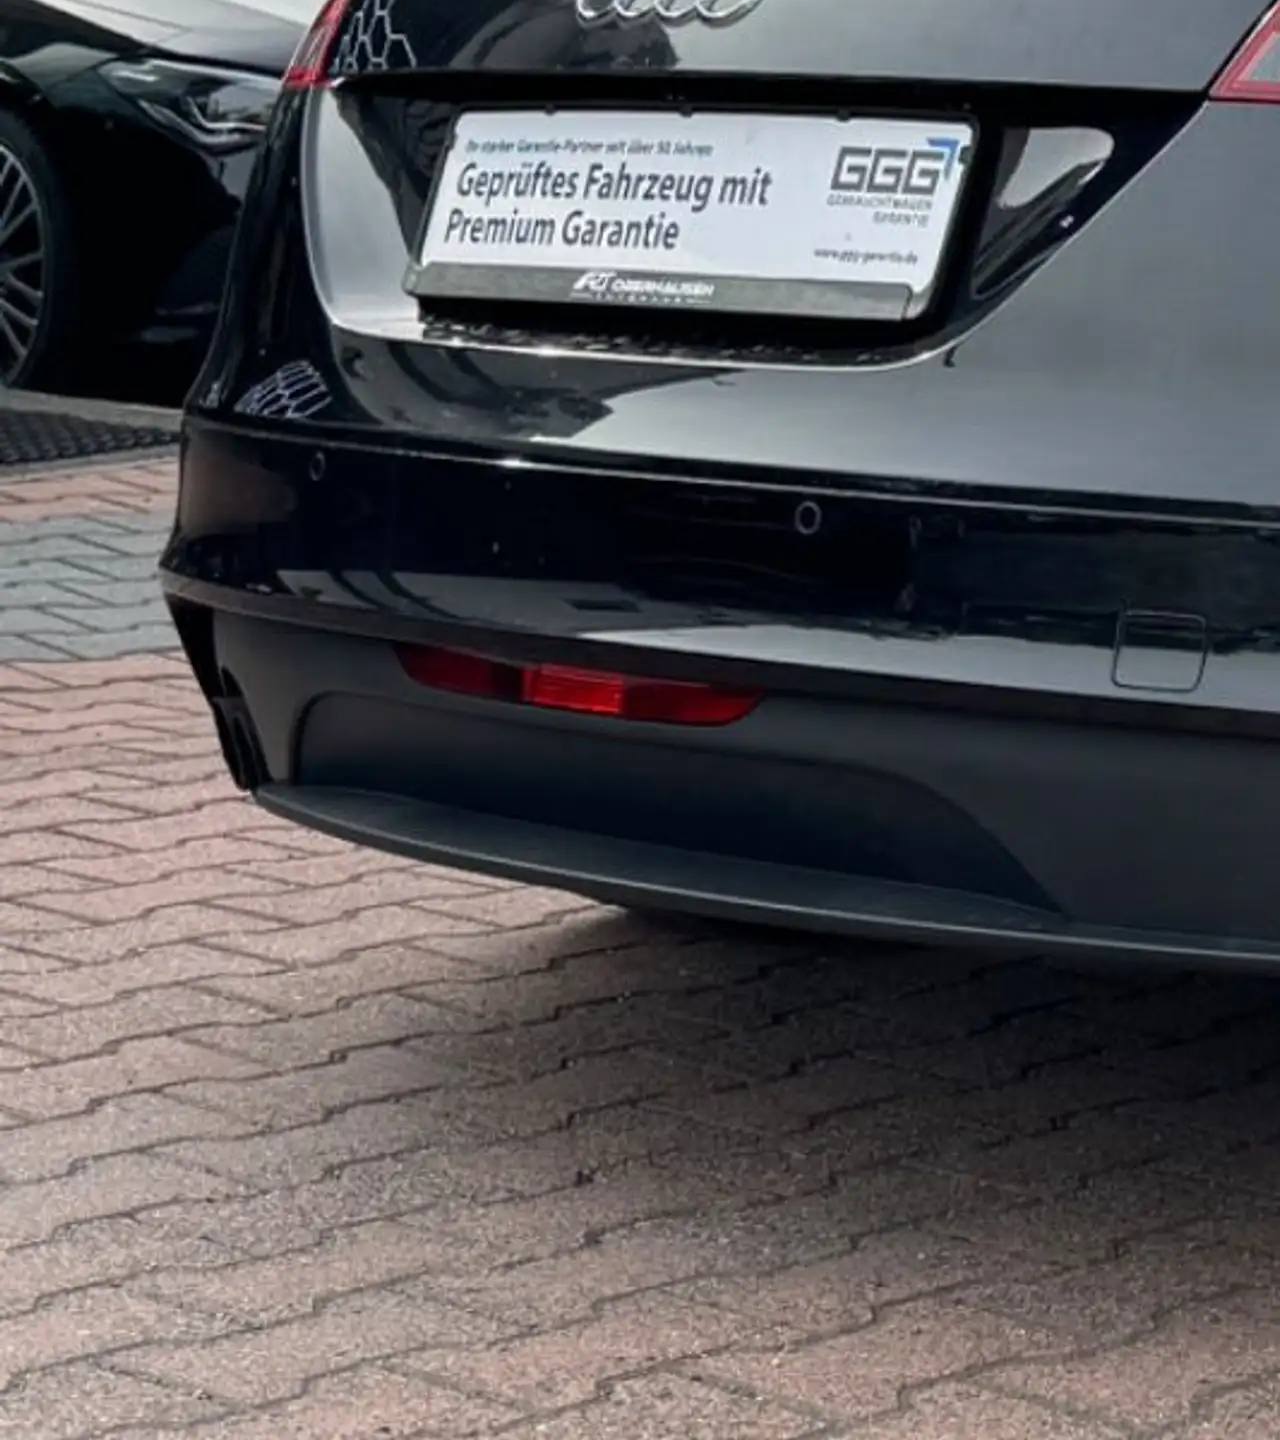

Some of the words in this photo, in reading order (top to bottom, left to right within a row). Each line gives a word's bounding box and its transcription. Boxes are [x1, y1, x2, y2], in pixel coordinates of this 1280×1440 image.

[457, 160, 579, 207] Geprüftes
[583, 162, 713, 212] Fahrzeug
[718, 166, 772, 206] mit
[830, 146, 945, 195] GGG
[444, 207, 555, 246] Premium
[562, 209, 680, 250] Garantie
